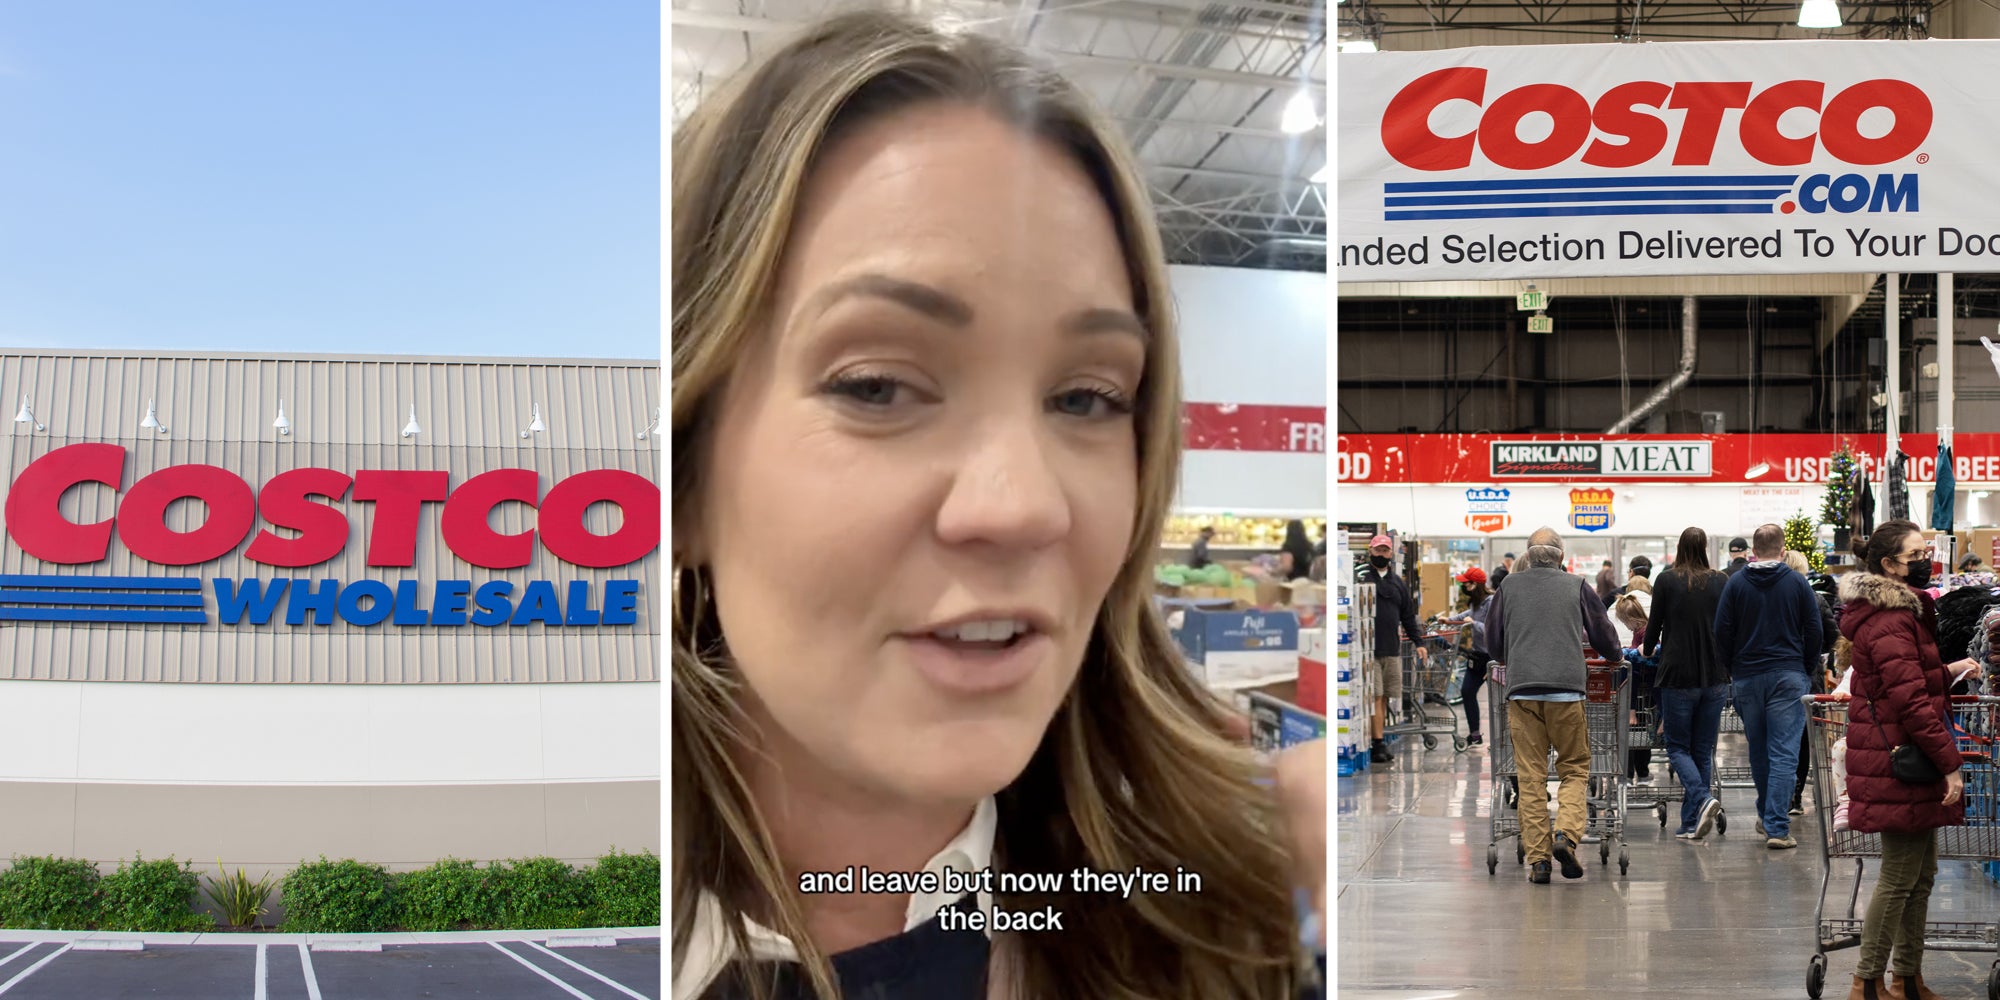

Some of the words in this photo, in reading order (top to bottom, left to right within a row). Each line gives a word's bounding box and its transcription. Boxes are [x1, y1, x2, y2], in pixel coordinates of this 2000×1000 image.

[1381, 67, 1934, 171] COSTCO
[1338, 236, 1429, 266] nded
[1442, 232, 1605, 264] Selection
[1618, 229, 1782, 261] Delivered
[1794, 228, 1835, 258] To
[1845, 228, 1927, 257] Your
[1523, 292, 1542, 308] EXIT
[1532, 318, 1549, 331] EXIT
[1498, 446, 1598, 463] KIRKLAND
[1611, 446, 1700, 472] MEAT
[1497, 461, 1597, 475] Signature
[1468, 490, 1509, 501] U.S.D.A.
[1571, 491, 1611, 503] U.S.D.A.
[4, 443, 660, 569] COSTCO
[1469, 502, 1506, 511] CHOICE
[1574, 504, 1609, 512] PRIME
[1575, 515, 1608, 527] BEEF
[213, 578, 639, 627] WHOLESALE
